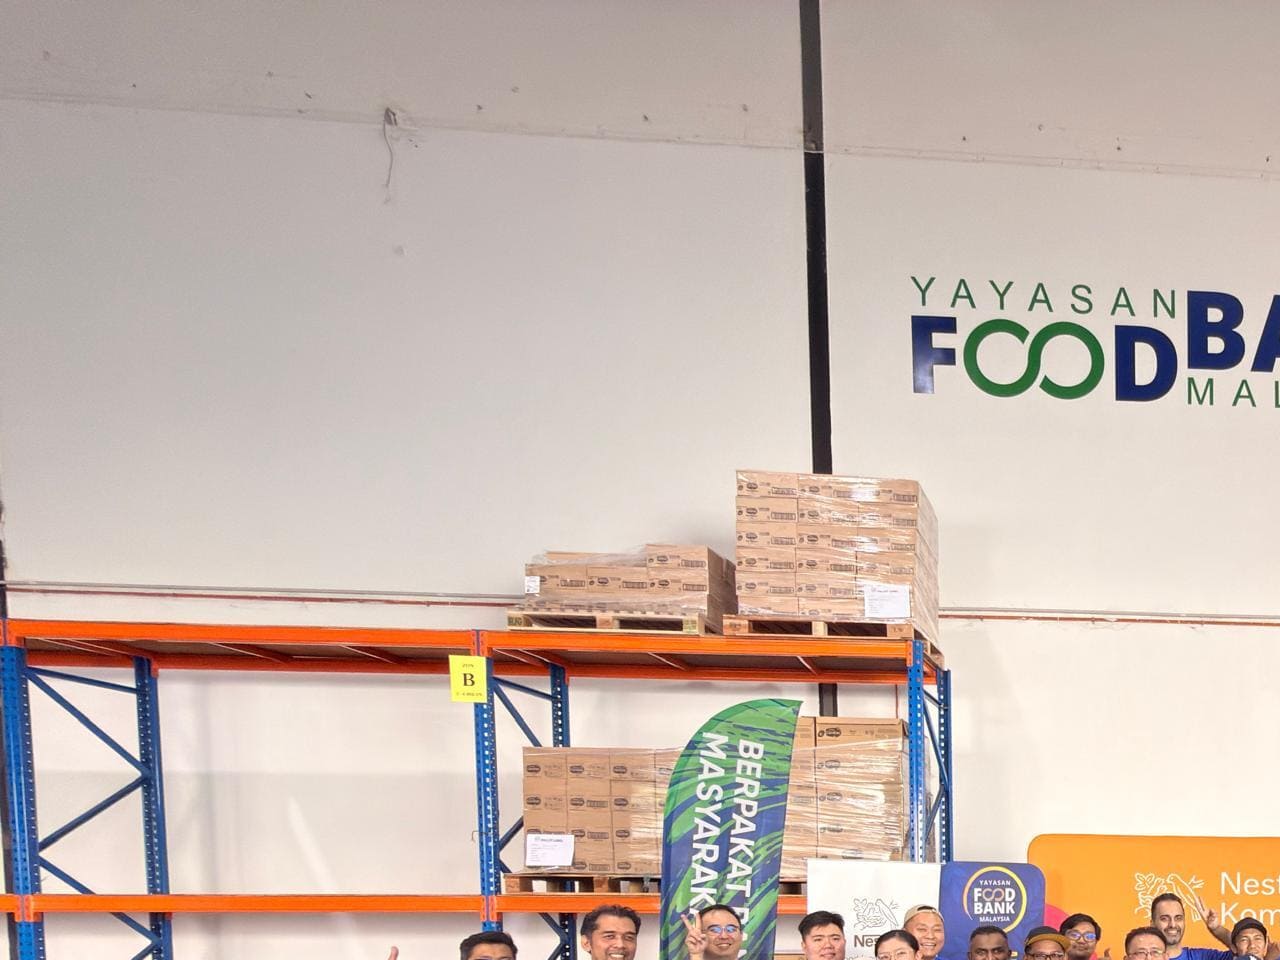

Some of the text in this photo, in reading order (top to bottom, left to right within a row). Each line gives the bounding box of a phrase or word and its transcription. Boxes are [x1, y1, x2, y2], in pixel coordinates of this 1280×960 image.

[911, 276, 1176, 319] YAYASAN
[911, 315, 1178, 402] FOOD
[463, 672, 475, 687] B
[689, 731, 729, 917] MASYARAK
[726, 739, 764, 899] BERPAKAT
[974, 888, 1016, 902] FOOD
[974, 901, 1015, 915] BANK
[853, 934, 877, 948] Nes
